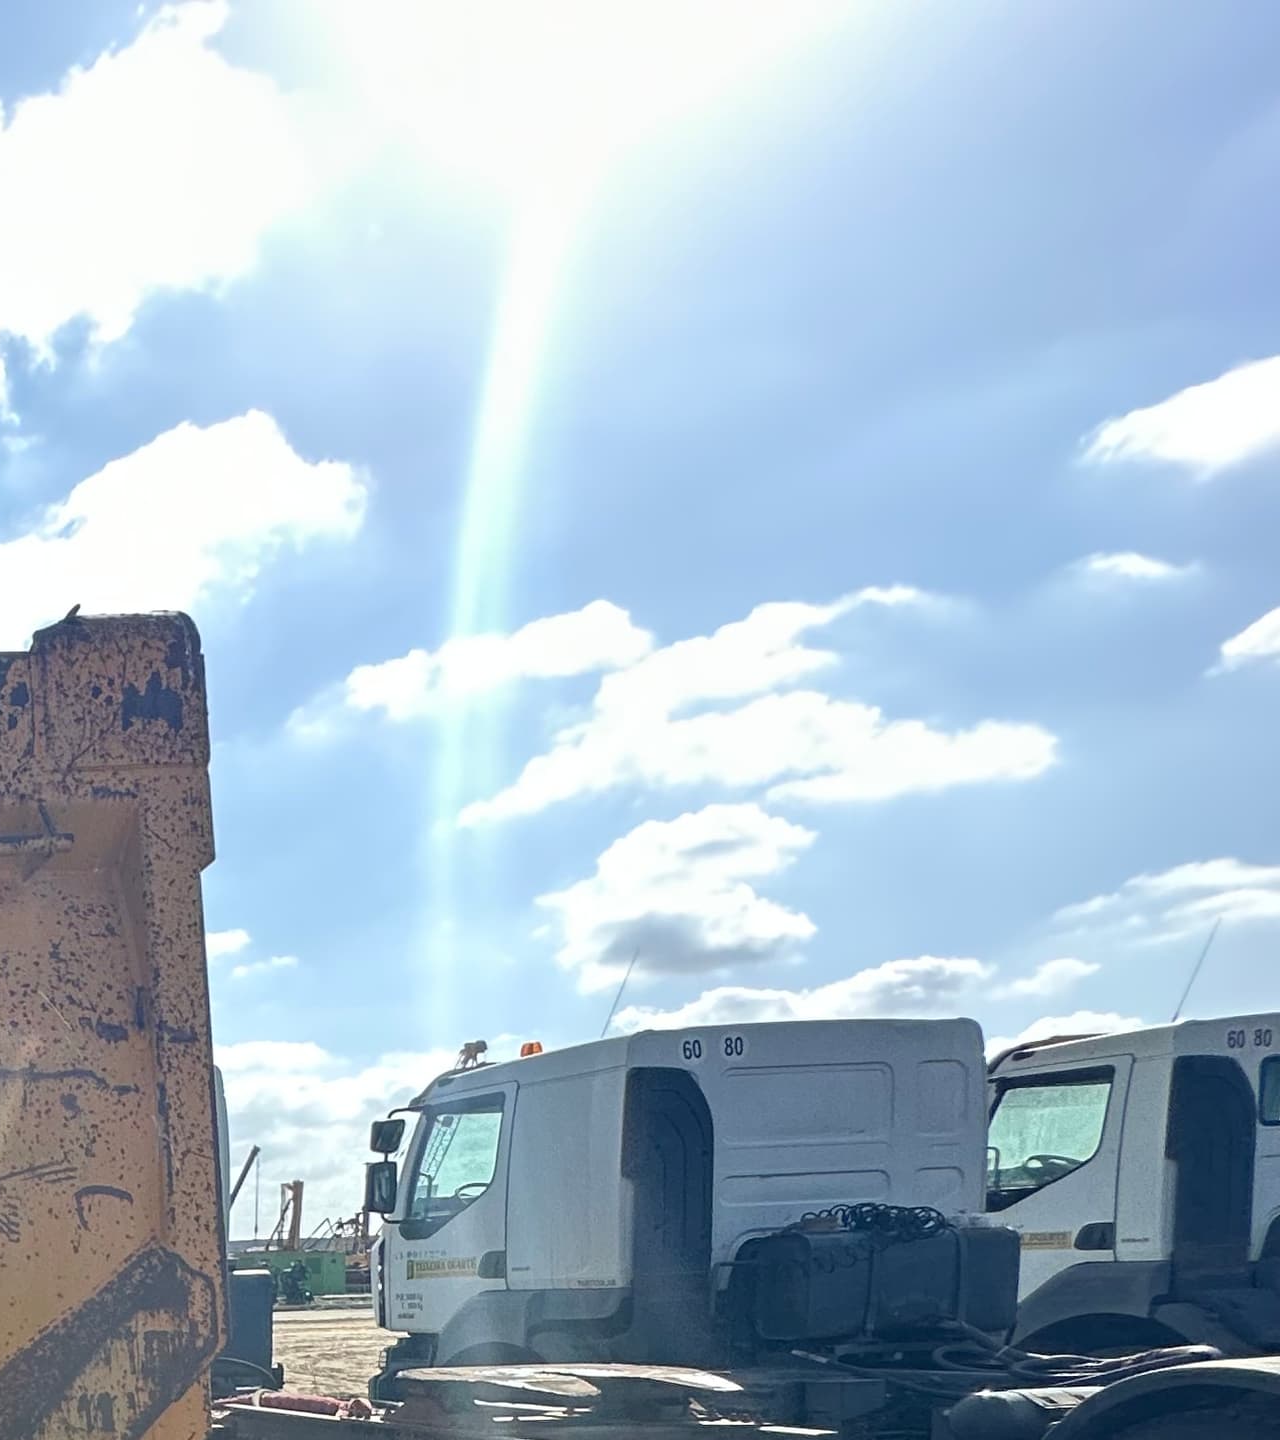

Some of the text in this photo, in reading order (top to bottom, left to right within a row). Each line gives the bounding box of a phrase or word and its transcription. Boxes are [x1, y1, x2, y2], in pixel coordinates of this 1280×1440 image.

[683, 1036, 743, 1060] 60 80
[1227, 1028, 1272, 1049] 60 80
